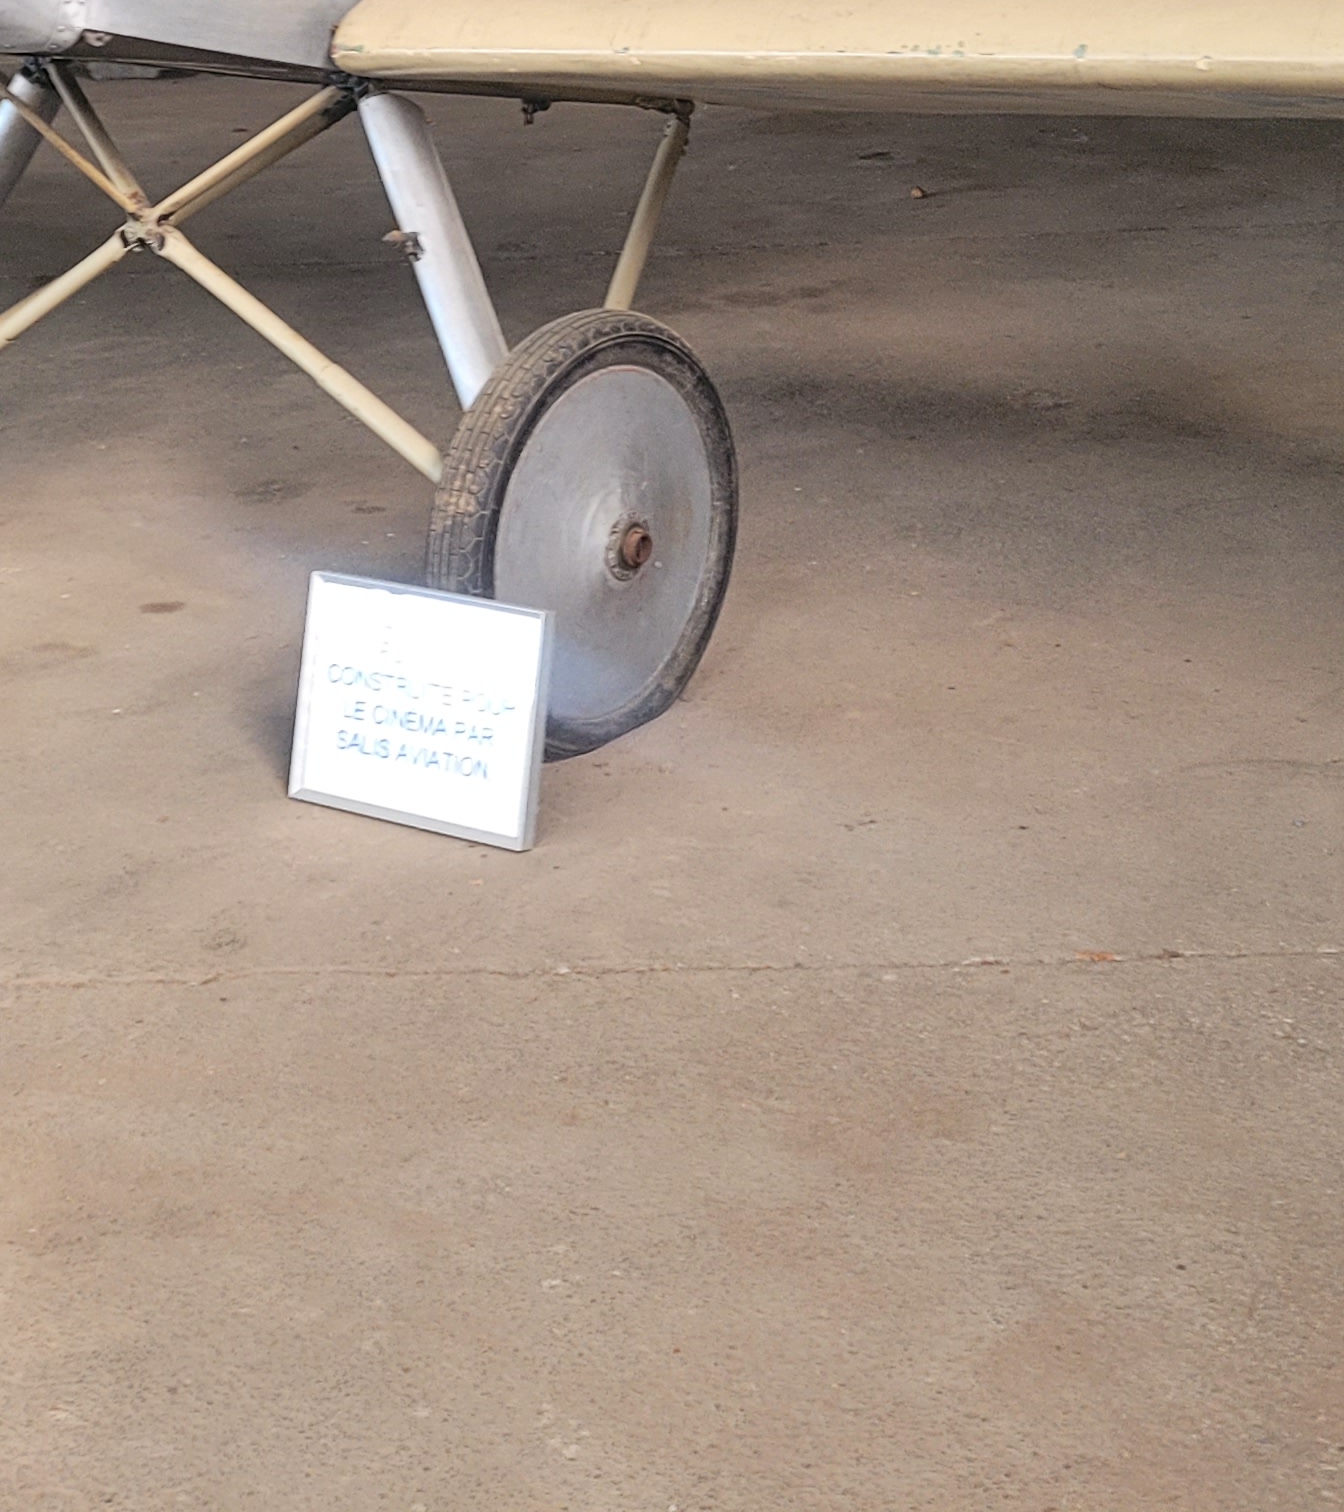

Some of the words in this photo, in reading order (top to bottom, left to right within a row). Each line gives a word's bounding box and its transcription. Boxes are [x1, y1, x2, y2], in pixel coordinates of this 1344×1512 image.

[343, 699, 367, 722] LE
[453, 720, 495, 748] PAR
[335, 728, 391, 760] SALIS
